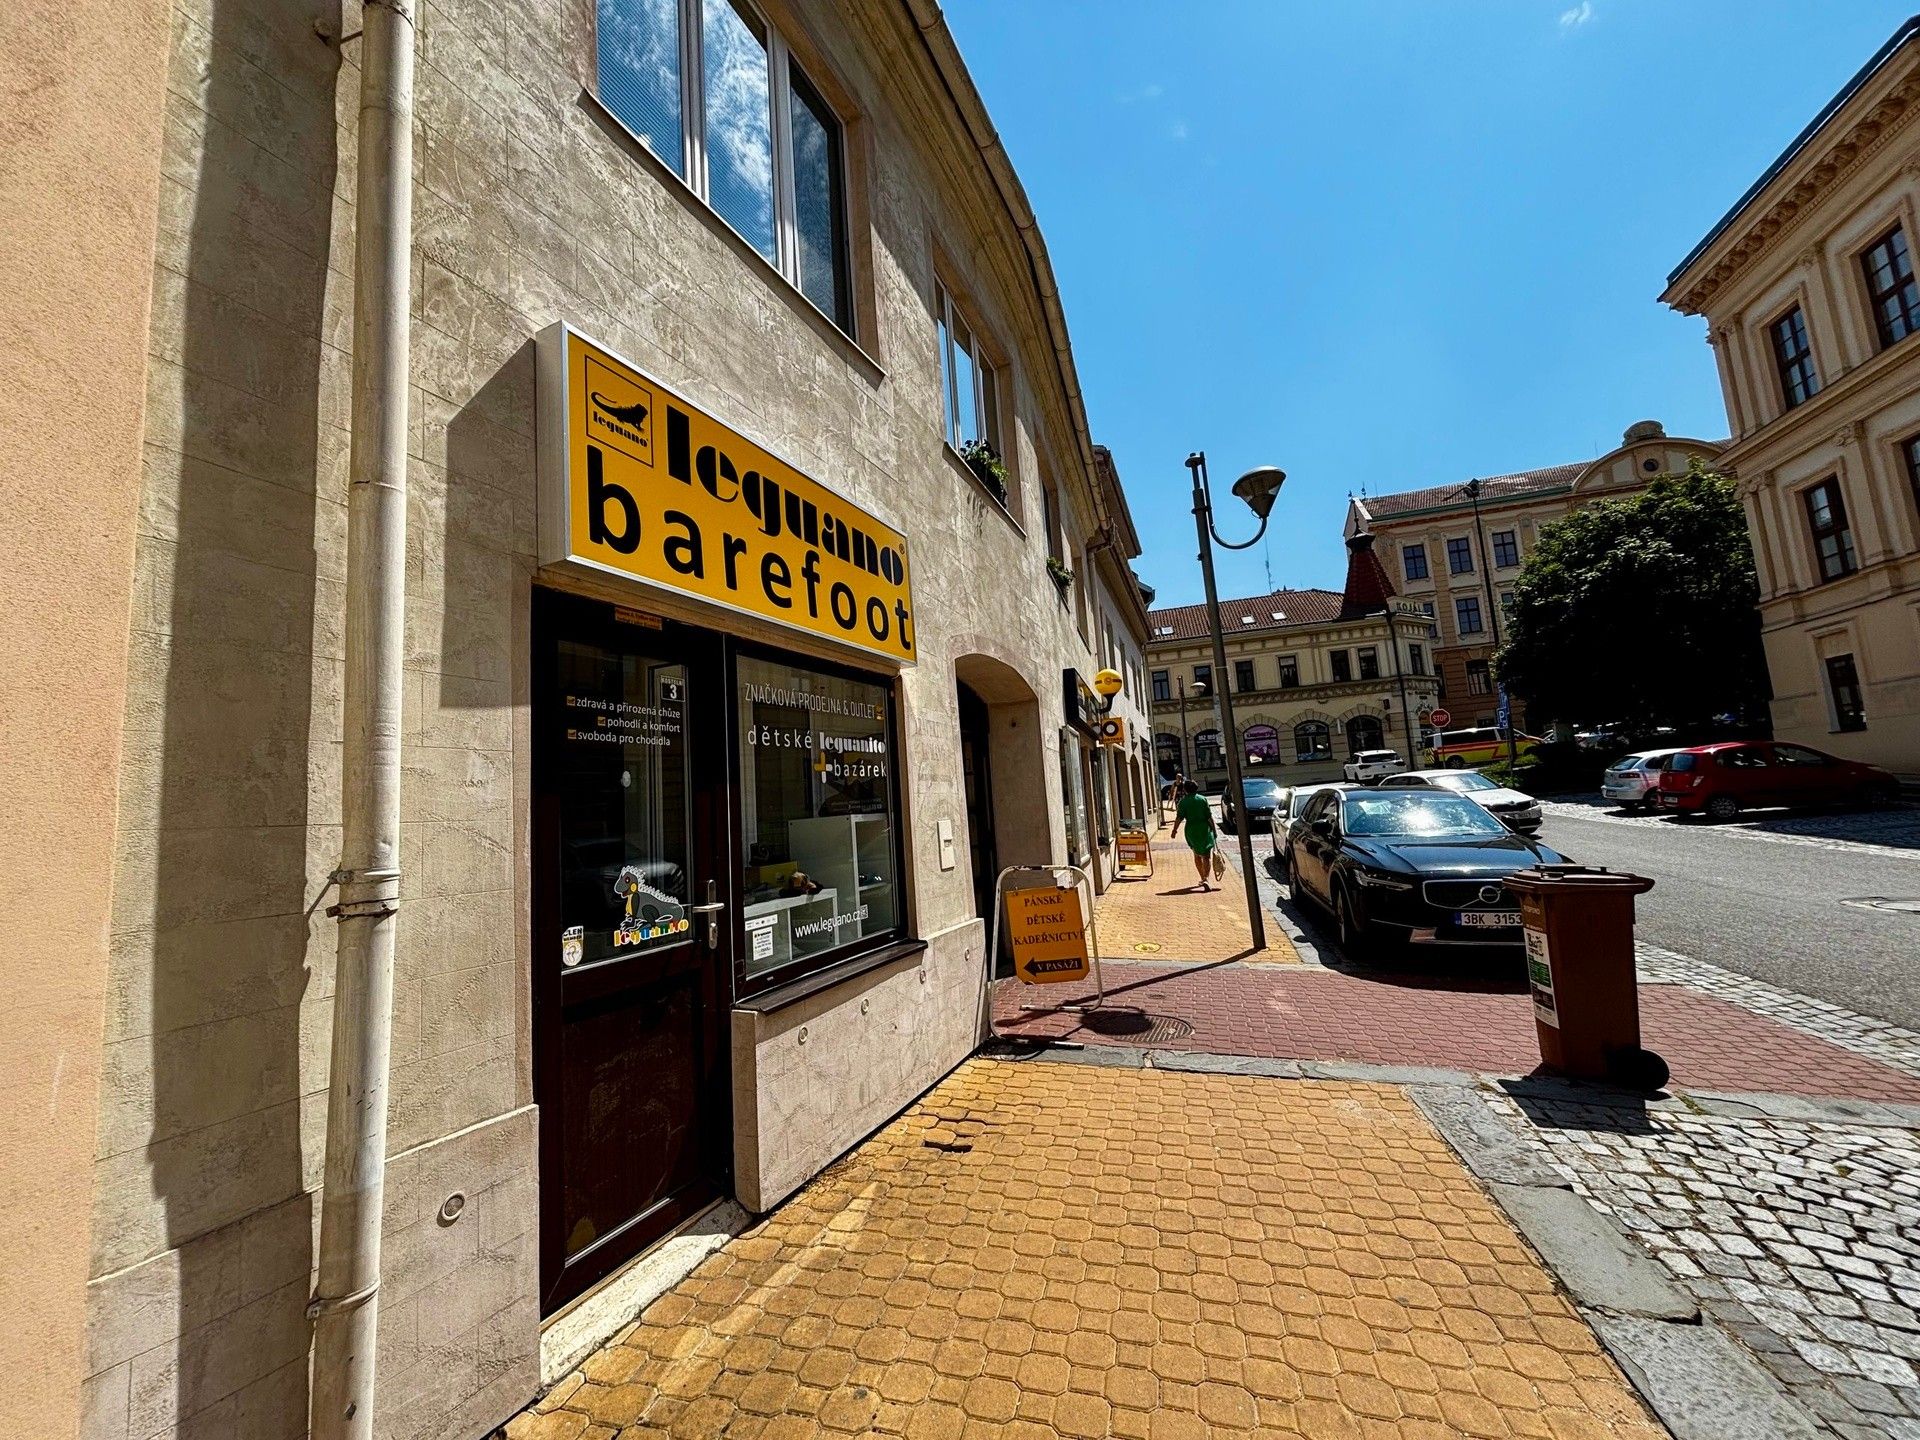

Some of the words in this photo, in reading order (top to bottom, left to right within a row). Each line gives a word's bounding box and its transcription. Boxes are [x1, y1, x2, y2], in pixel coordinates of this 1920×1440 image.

[593, 411, 648, 448] leguano
[666, 404, 904, 587] leguano
[586, 444, 911, 651] barefoot
[669, 684, 677, 700] 3
[576, 696, 607, 710] zdravá
[609, 703, 615, 711] a
[616, 702, 657, 716] přirozená
[658, 707, 681, 719] chůze
[745, 683, 797, 708] ZNAČKOVÁ
[799, 692, 841, 715] PRODEJNA
[843, 700, 849, 716] &
[850, 702, 875, 719] OUTLET
[607, 717, 641, 729] pohodlí
[642, 722, 648, 730] a
[649, 720, 681, 733] komfort
[1432, 714, 1448, 722] STOP
[577, 730, 617, 743] svoboda
[619, 735, 634, 746] pro
[635, 734, 671, 746] chodidla
[747, 725, 812, 748] dětské
[819, 732, 886, 754] leguanito
[834, 759, 887, 778] bazárek
[1024, 894, 1063, 907] PÁNSKÉ
[794, 909, 861, 939] www.leguano.cz
[1026, 912, 1066, 926] DĚTSKÉ
[1464, 913, 1485, 925] 3BK
[1494, 913, 1522, 925] 3153
[1046, 960, 1079, 971] PASÁŽI
